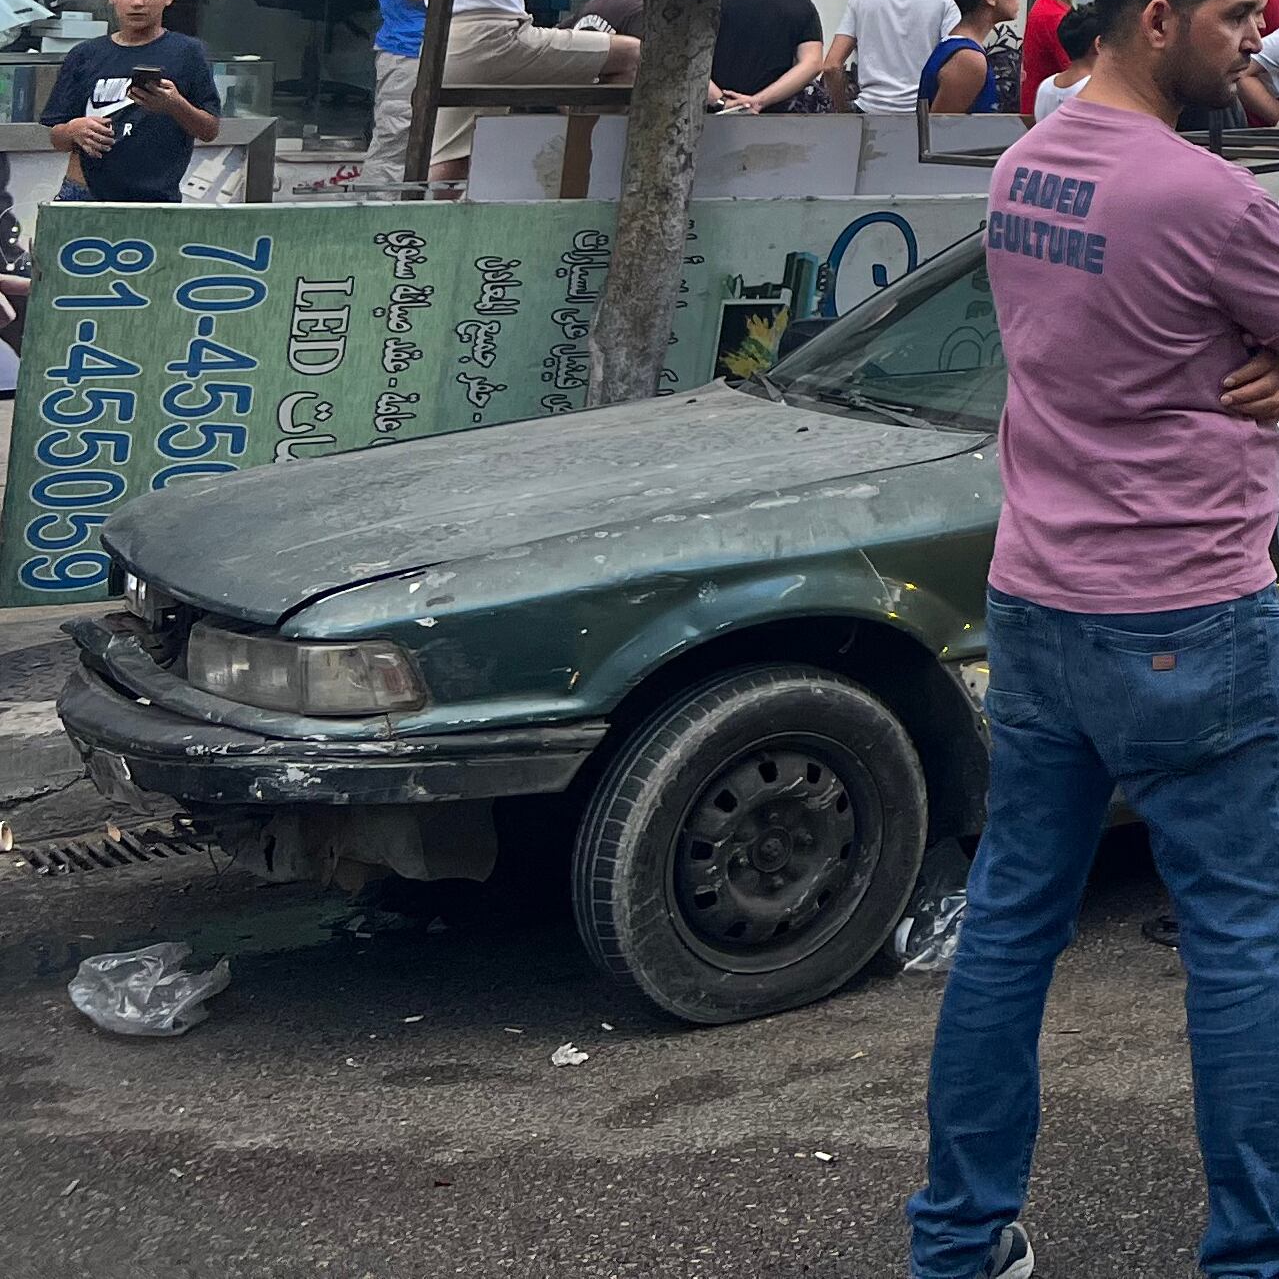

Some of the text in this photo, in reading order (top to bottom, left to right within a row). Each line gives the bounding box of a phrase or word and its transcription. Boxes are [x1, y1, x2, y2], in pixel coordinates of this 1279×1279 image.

[93, 77, 133, 103] NIK
[1008, 166, 1096, 219] FADED
[986, 210, 1107, 275] CULTURE
[474, 255, 523, 317] المعادن
[286, 276, 355, 377] LED
[454, 320, 502, 369] جميع
[17, 236, 157, 593] 81-455059
